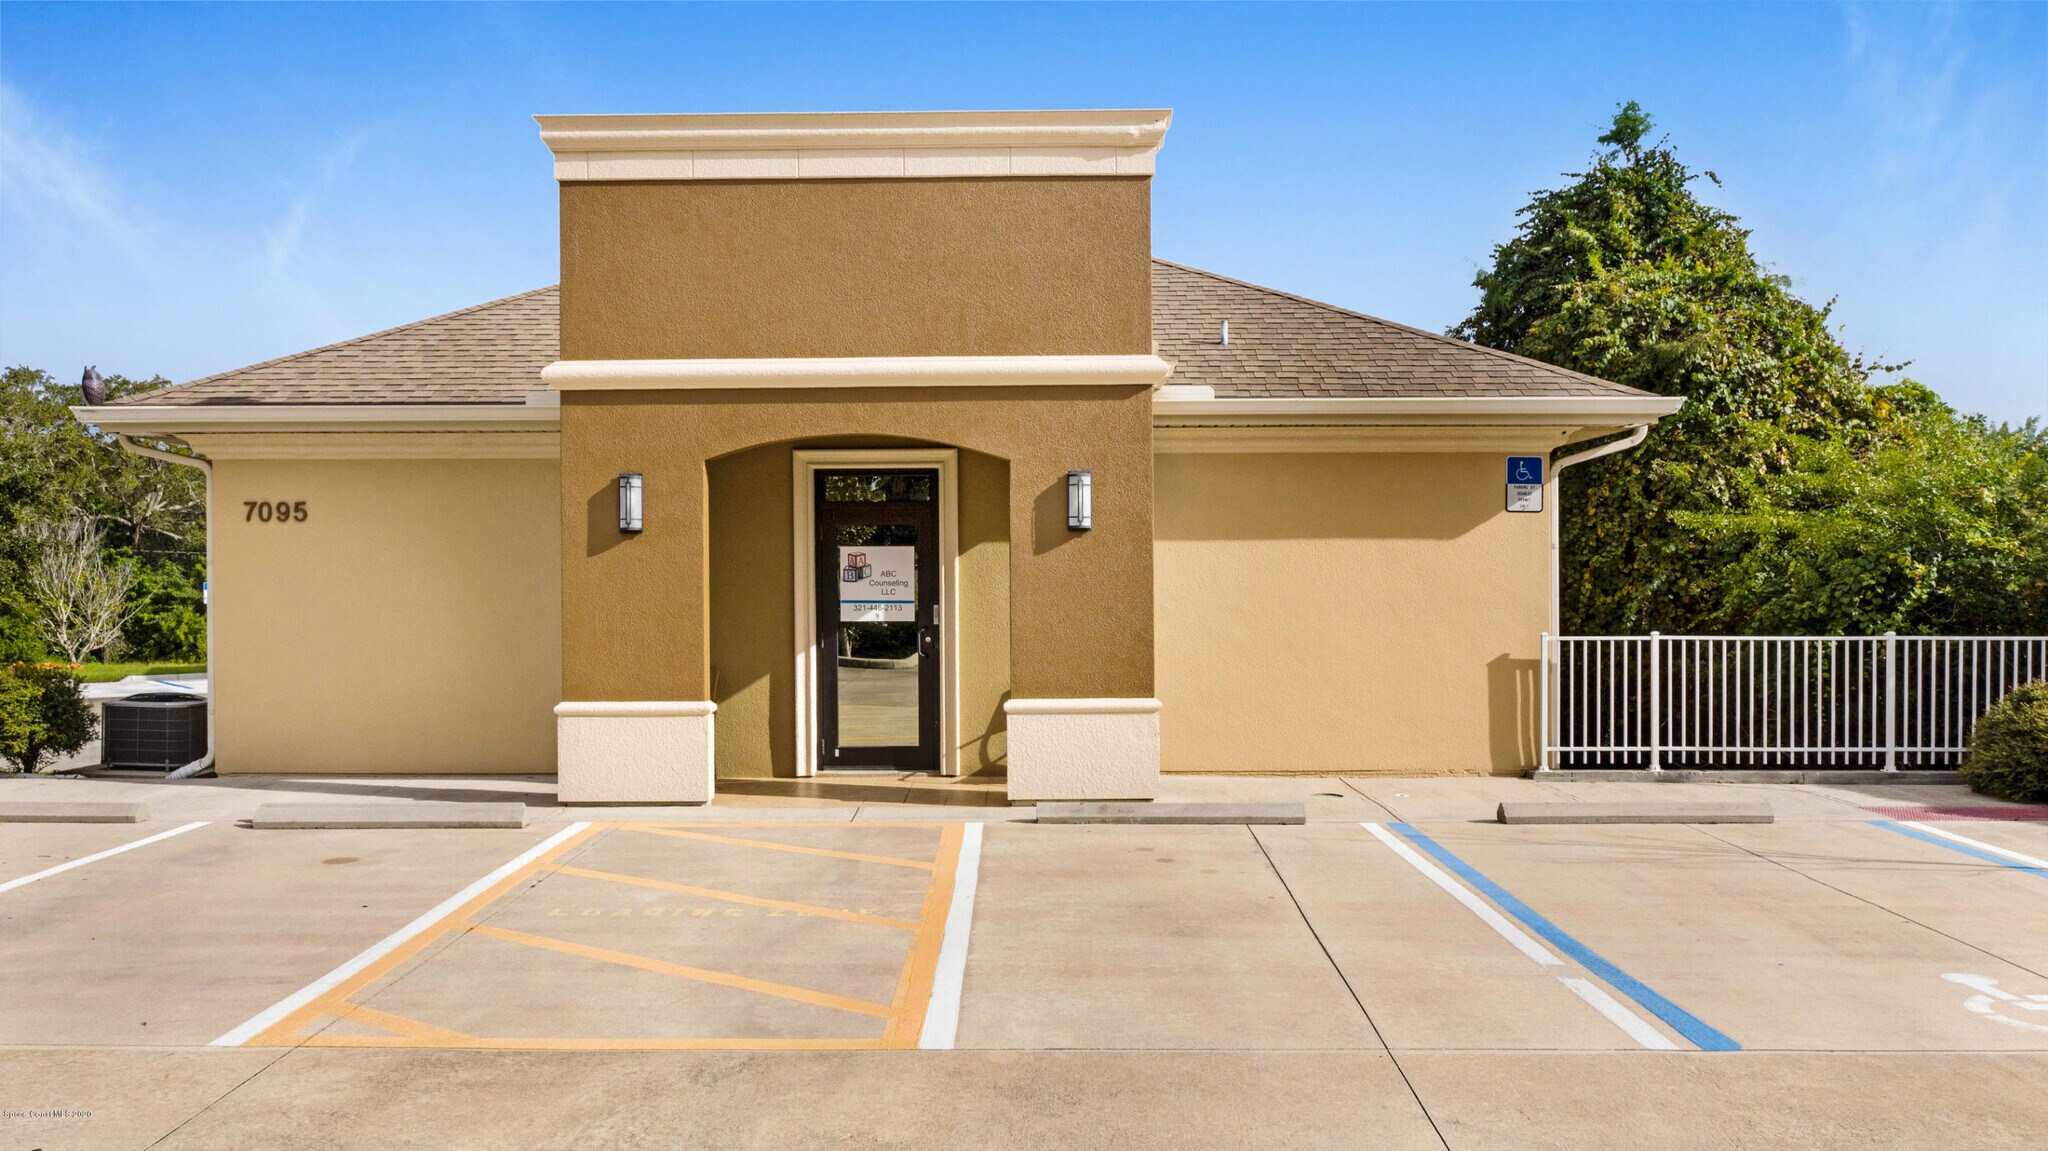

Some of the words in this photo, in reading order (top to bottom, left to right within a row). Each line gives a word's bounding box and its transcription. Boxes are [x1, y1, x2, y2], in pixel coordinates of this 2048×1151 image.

[243, 501, 308, 523] 7095
[847, 571, 854, 580] B
[880, 570, 897, 578] ABC
[869, 580, 908, 588] Counseling
[881, 588, 896, 596] LLC
[765, 907, 881, 917] ZOE
